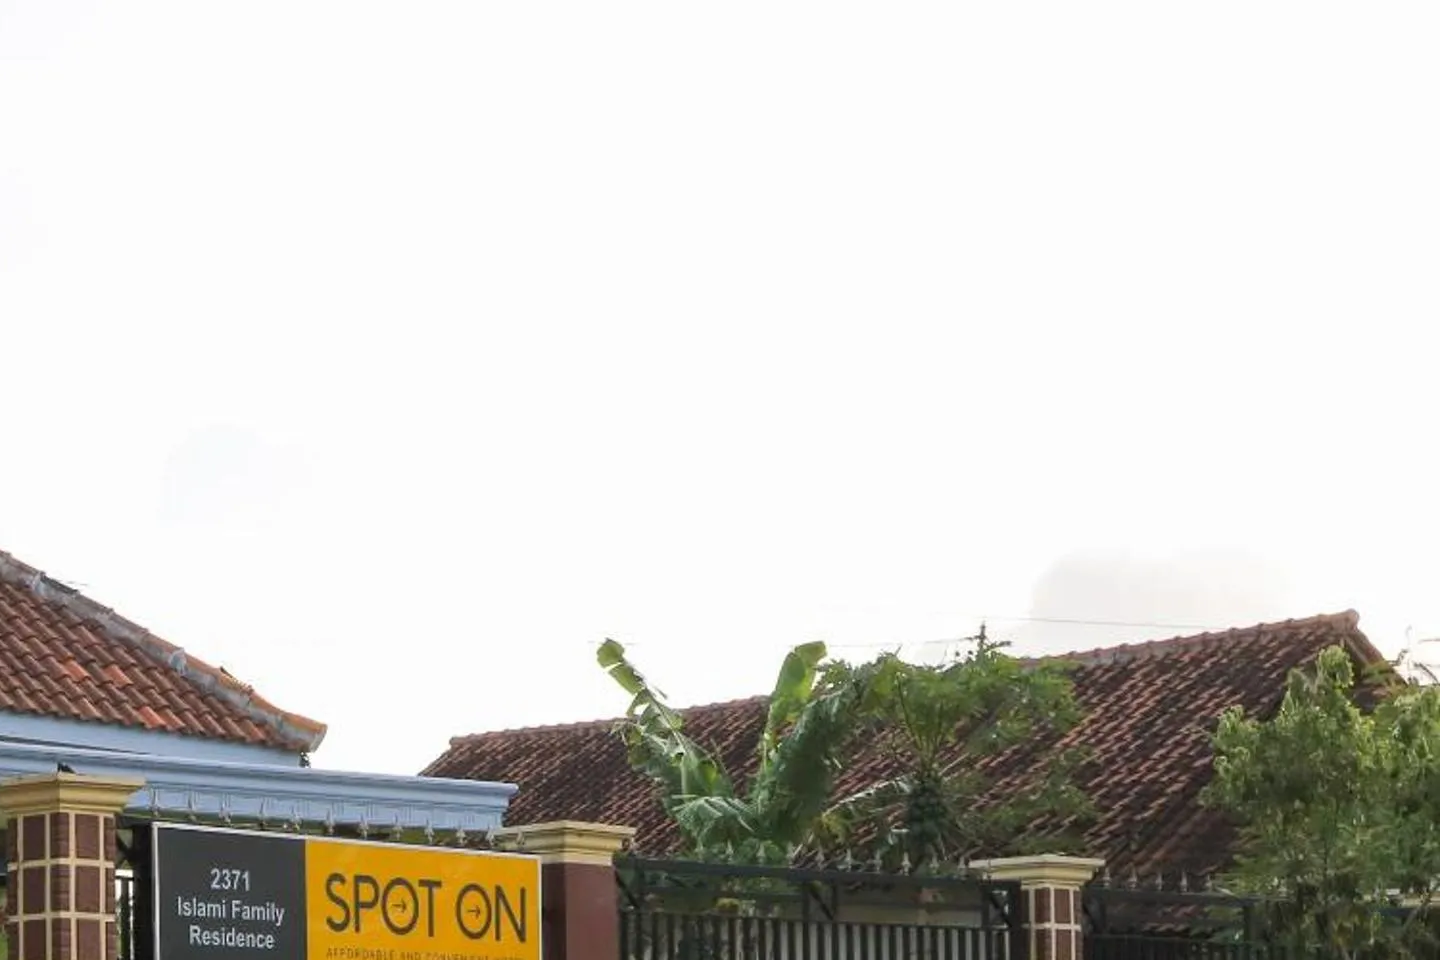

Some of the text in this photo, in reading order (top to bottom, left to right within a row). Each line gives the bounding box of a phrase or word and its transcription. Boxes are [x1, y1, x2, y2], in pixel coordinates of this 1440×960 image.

[210, 868, 250, 891] 2371
[177, 896, 285, 926] Islami Family
[325, 872, 526, 943] SPOT ON
[189, 925, 275, 949] Residence
